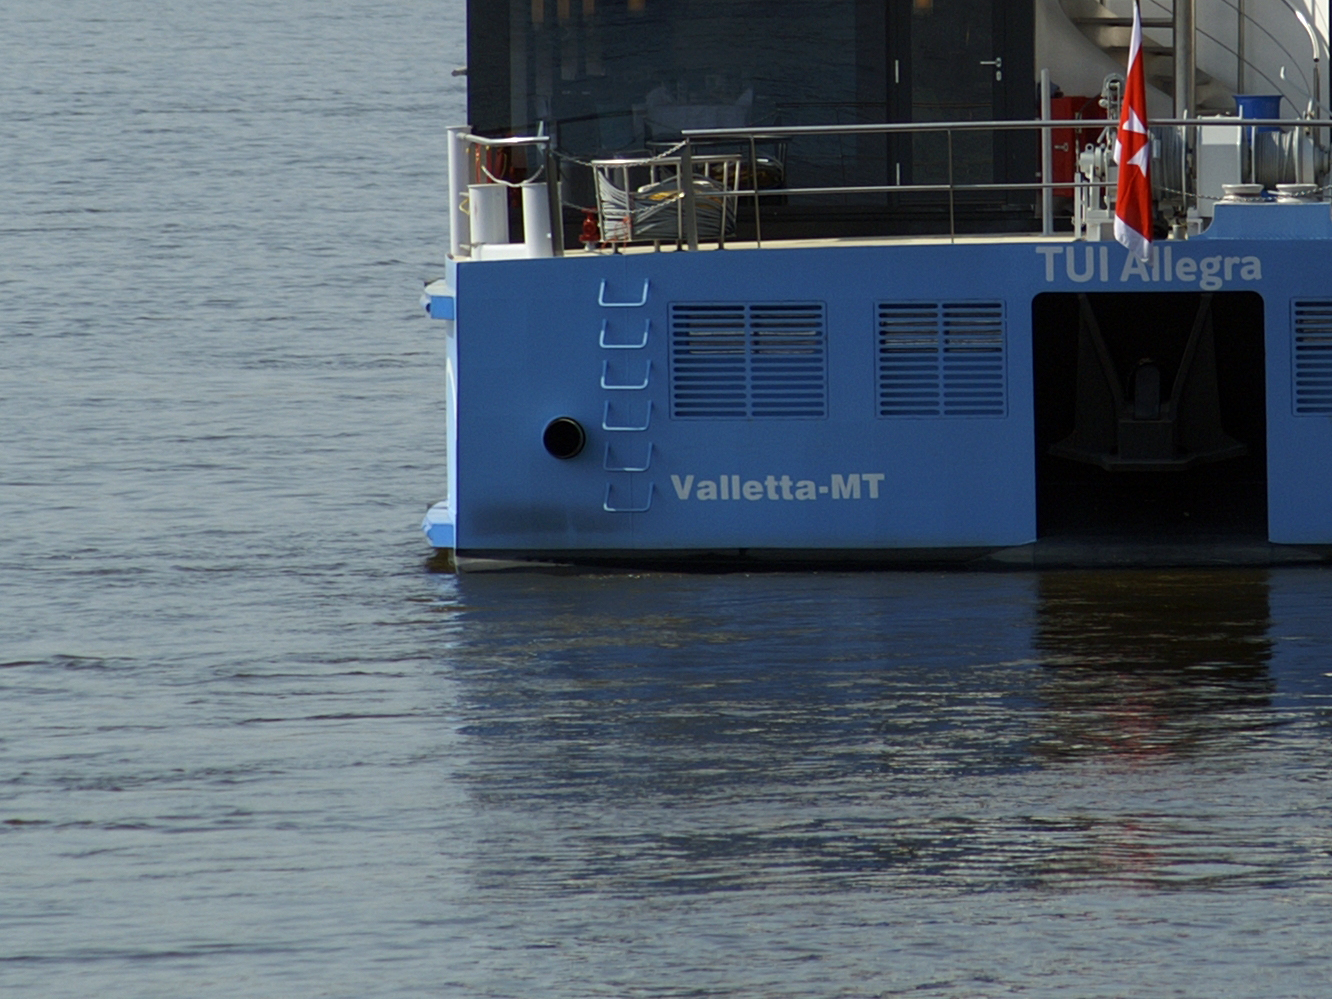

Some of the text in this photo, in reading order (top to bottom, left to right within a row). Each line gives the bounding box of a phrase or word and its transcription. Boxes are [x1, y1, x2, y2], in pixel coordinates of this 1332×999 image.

[1035, 245, 1262, 291] TUI Allegra
[670, 473, 885, 500] Valletta-MT
